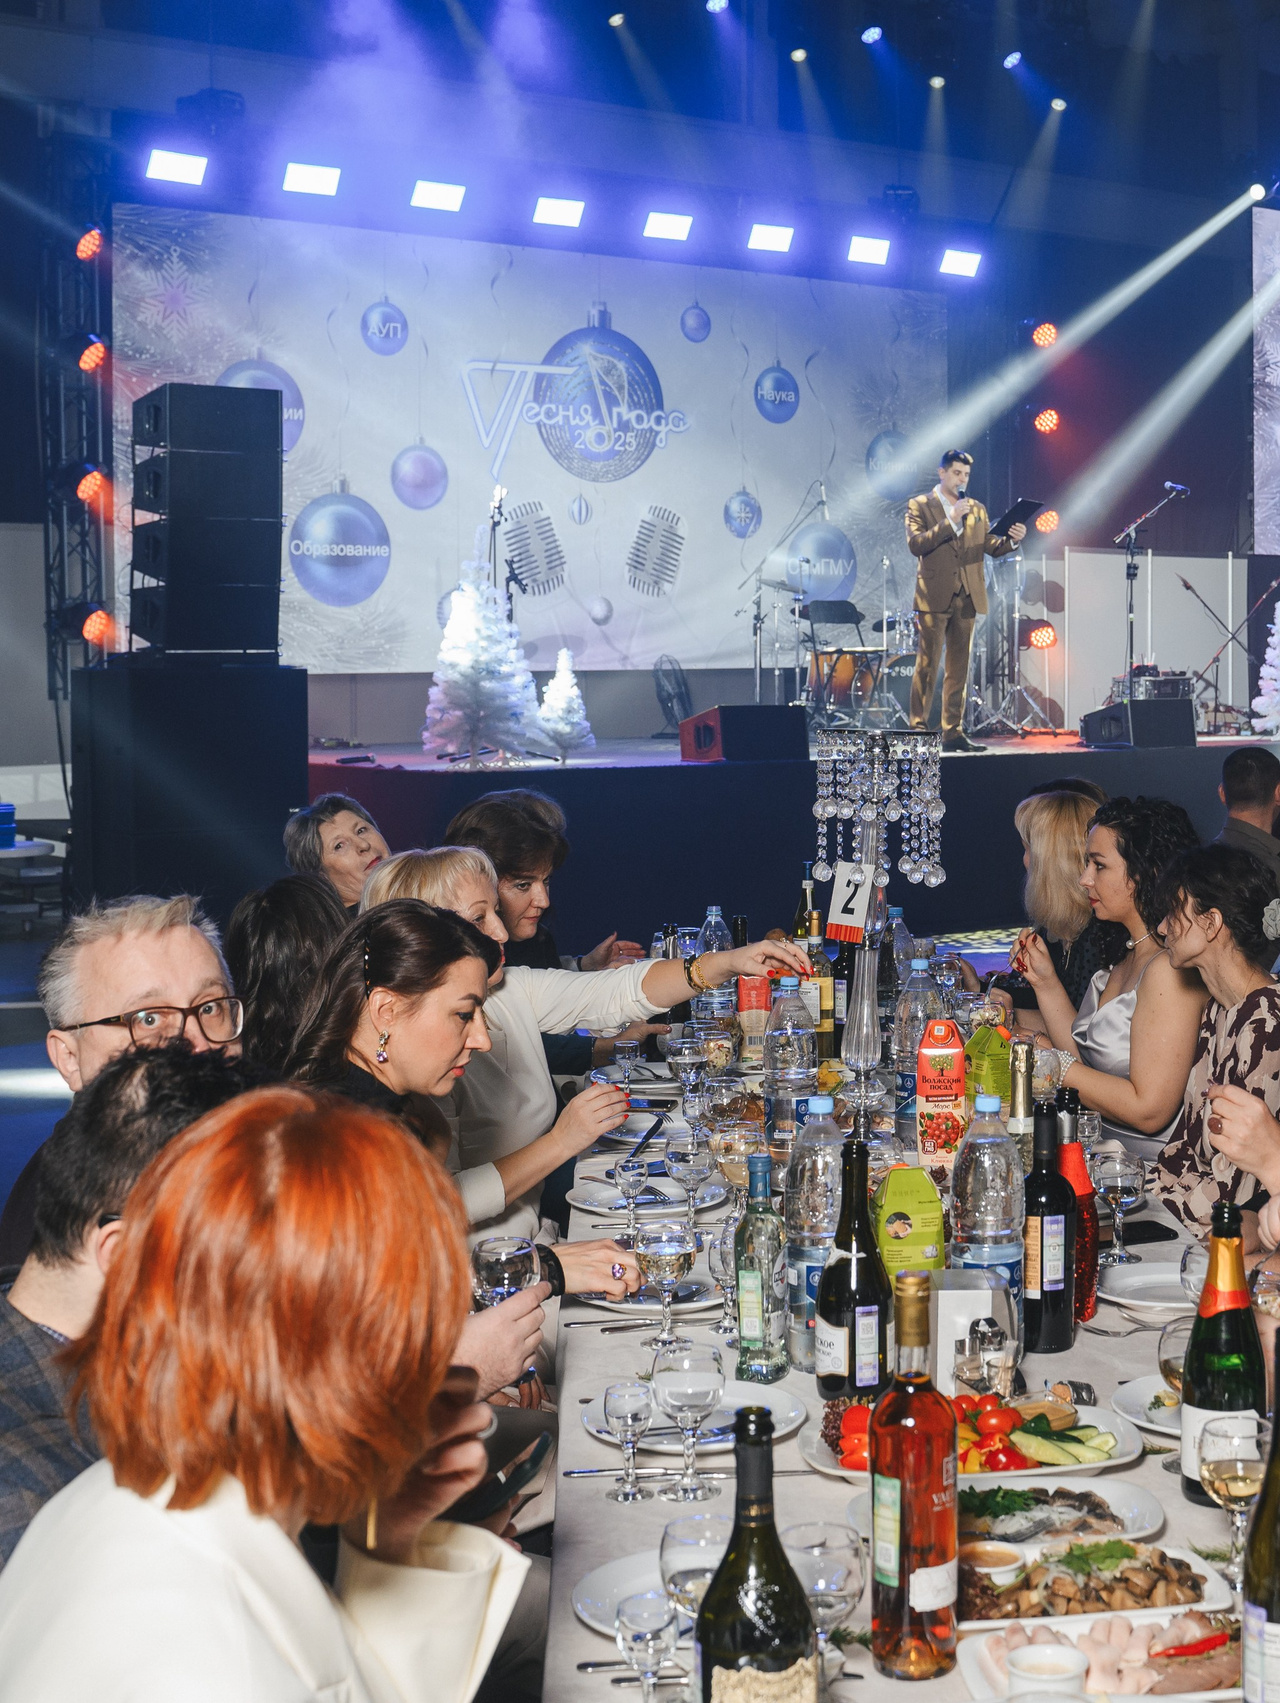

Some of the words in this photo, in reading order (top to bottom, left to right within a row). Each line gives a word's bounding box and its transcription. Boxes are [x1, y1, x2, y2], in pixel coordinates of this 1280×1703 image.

[367, 322, 402, 339] АУП
[757, 386, 795, 404] Наука
[611, 404, 691, 449] года
[868, 457, 918, 473] Клиники
[290, 539, 390, 559] Образование
[840, 877, 860, 915] 2
[922, 1075, 962, 1085] Волжский
[931, 1103, 951, 1111] Морс
